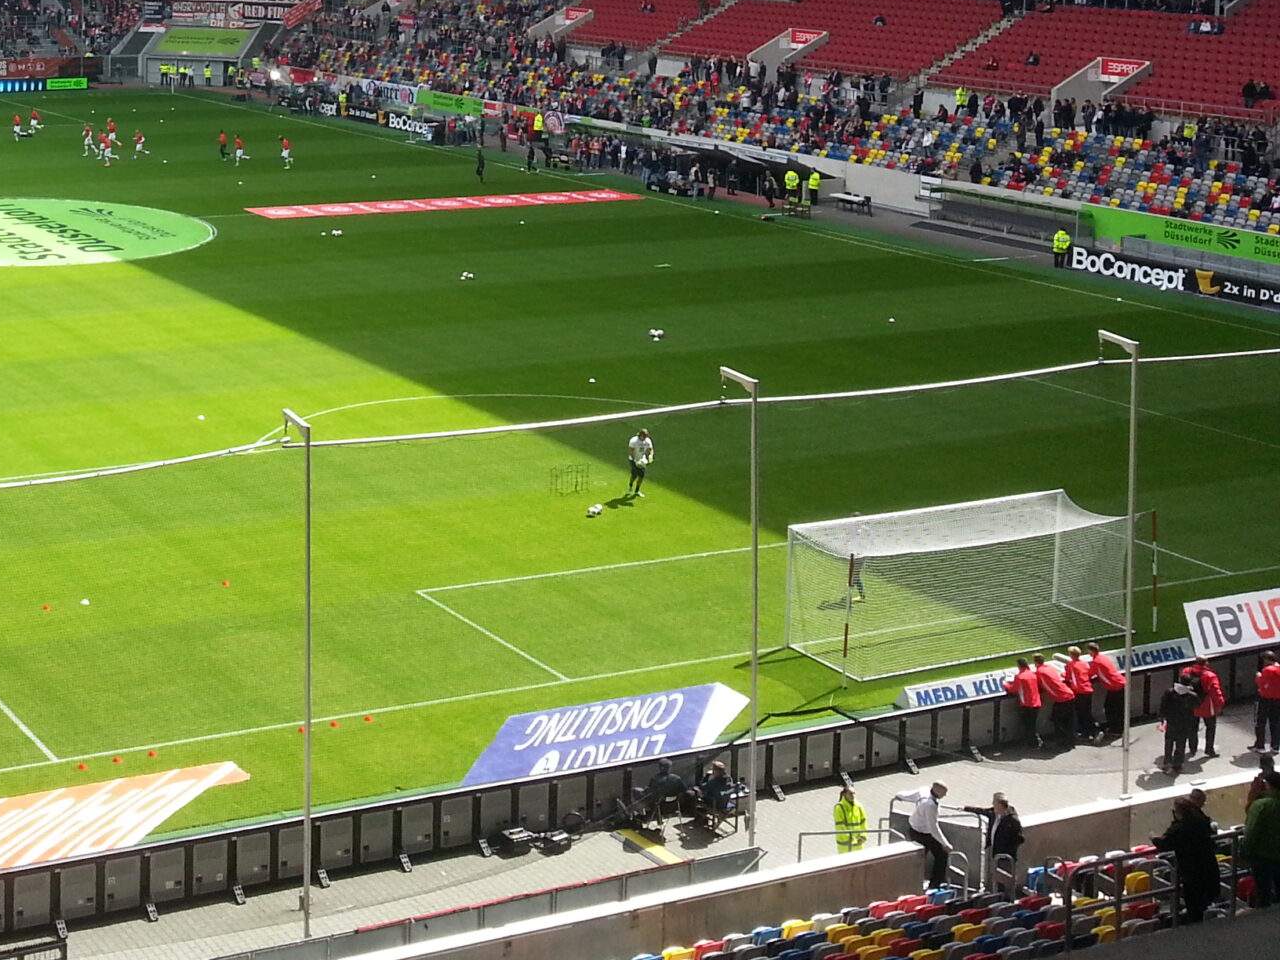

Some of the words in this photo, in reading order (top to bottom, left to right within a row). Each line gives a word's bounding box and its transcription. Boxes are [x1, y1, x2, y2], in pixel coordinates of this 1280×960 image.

[244, 4, 266, 18] RED
[1107, 62, 1138, 74] ESPRIT
[1164, 220, 1214, 236] Stadtwerke
[1163, 230, 1212, 246] Düsseldorf
[1071, 246, 1185, 291] BoConcept
[1223, 282, 1239, 294] 2x
[1243, 284, 1256, 298] in
[915, 683, 970, 707] MEDA
[972, 673, 1008, 695] KÜC
[514, 693, 684, 751] CONSULTING
